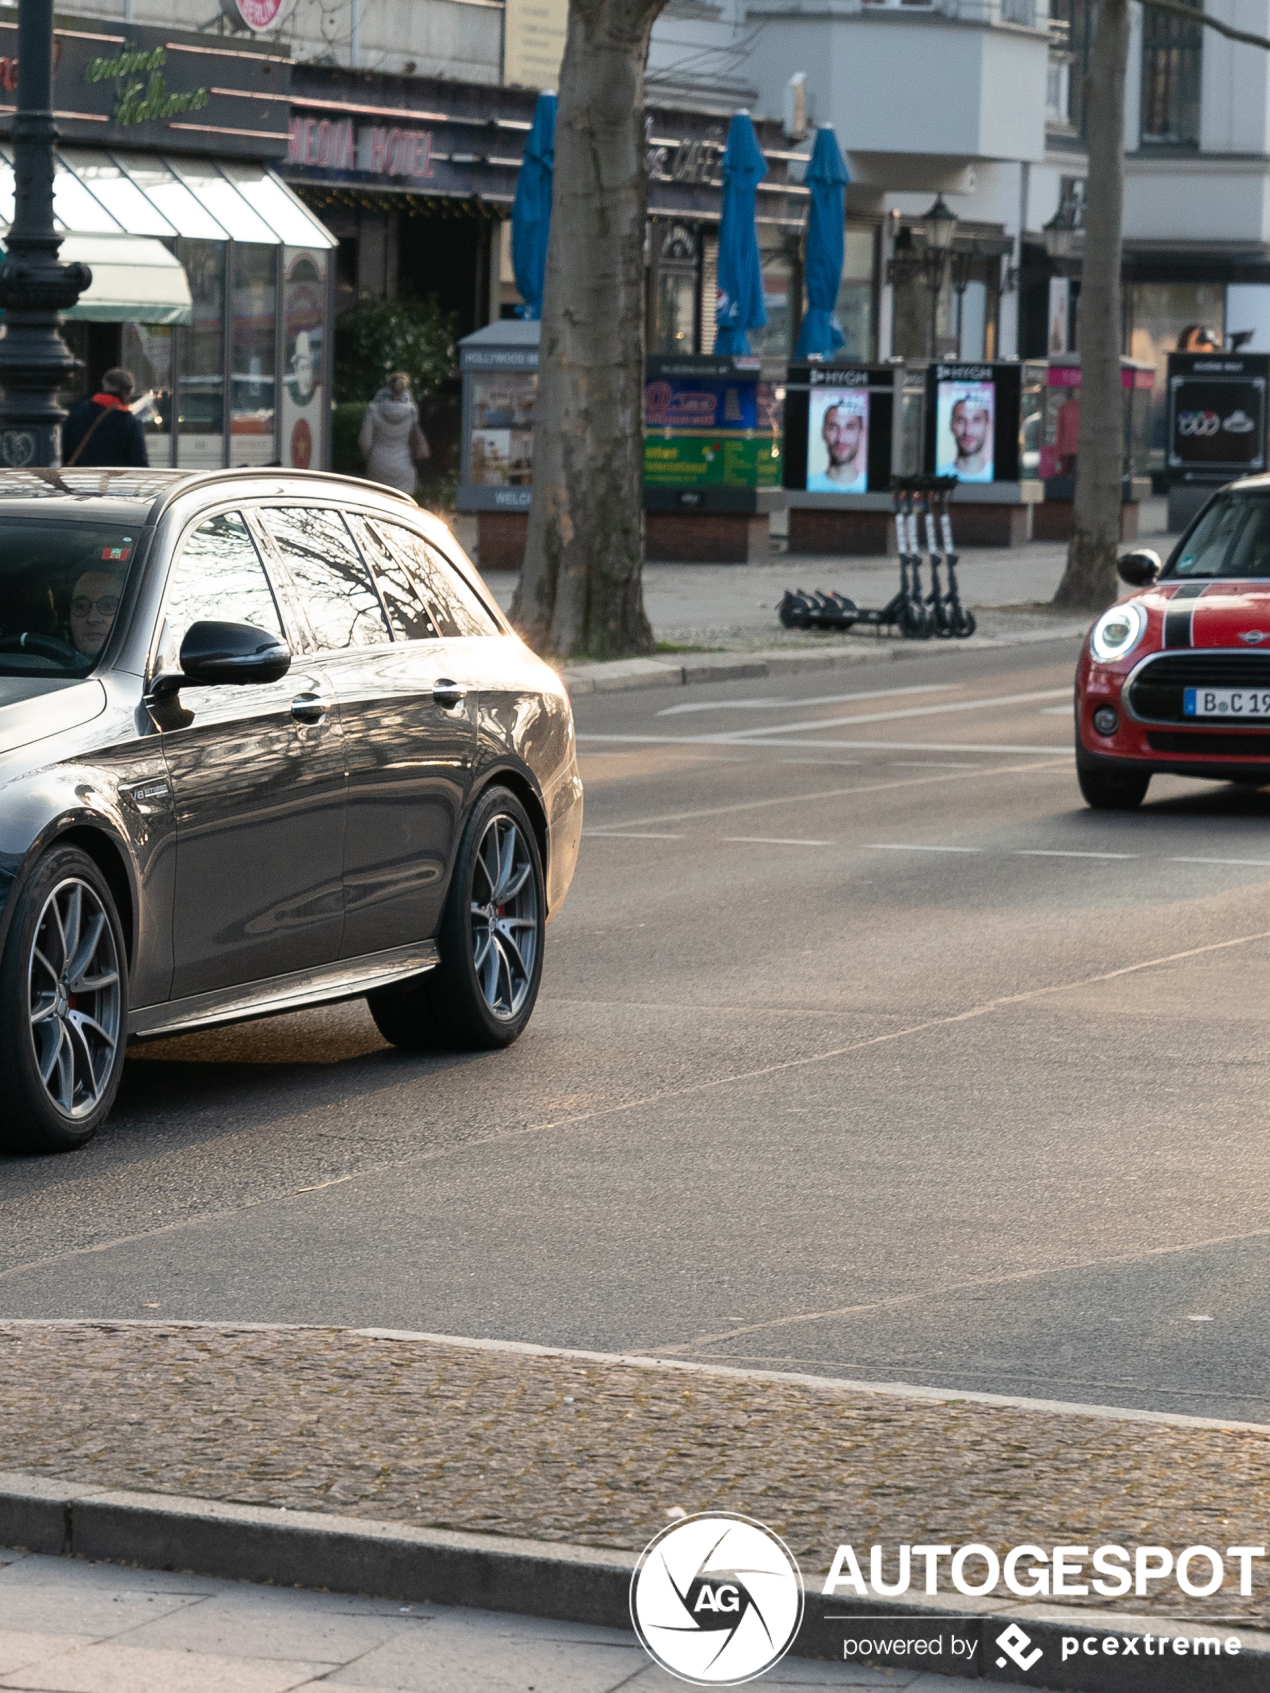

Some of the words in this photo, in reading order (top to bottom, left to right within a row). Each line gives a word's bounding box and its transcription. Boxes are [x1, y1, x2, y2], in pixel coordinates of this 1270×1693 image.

[288, 115, 356, 170] MEDIA
[369, 125, 434, 178] HOTEL
[826, 370, 868, 386] HYGH
[951, 365, 993, 382] HYGH
[1204, 692, 1217, 712] B
[1230, 692, 1244, 713] C
